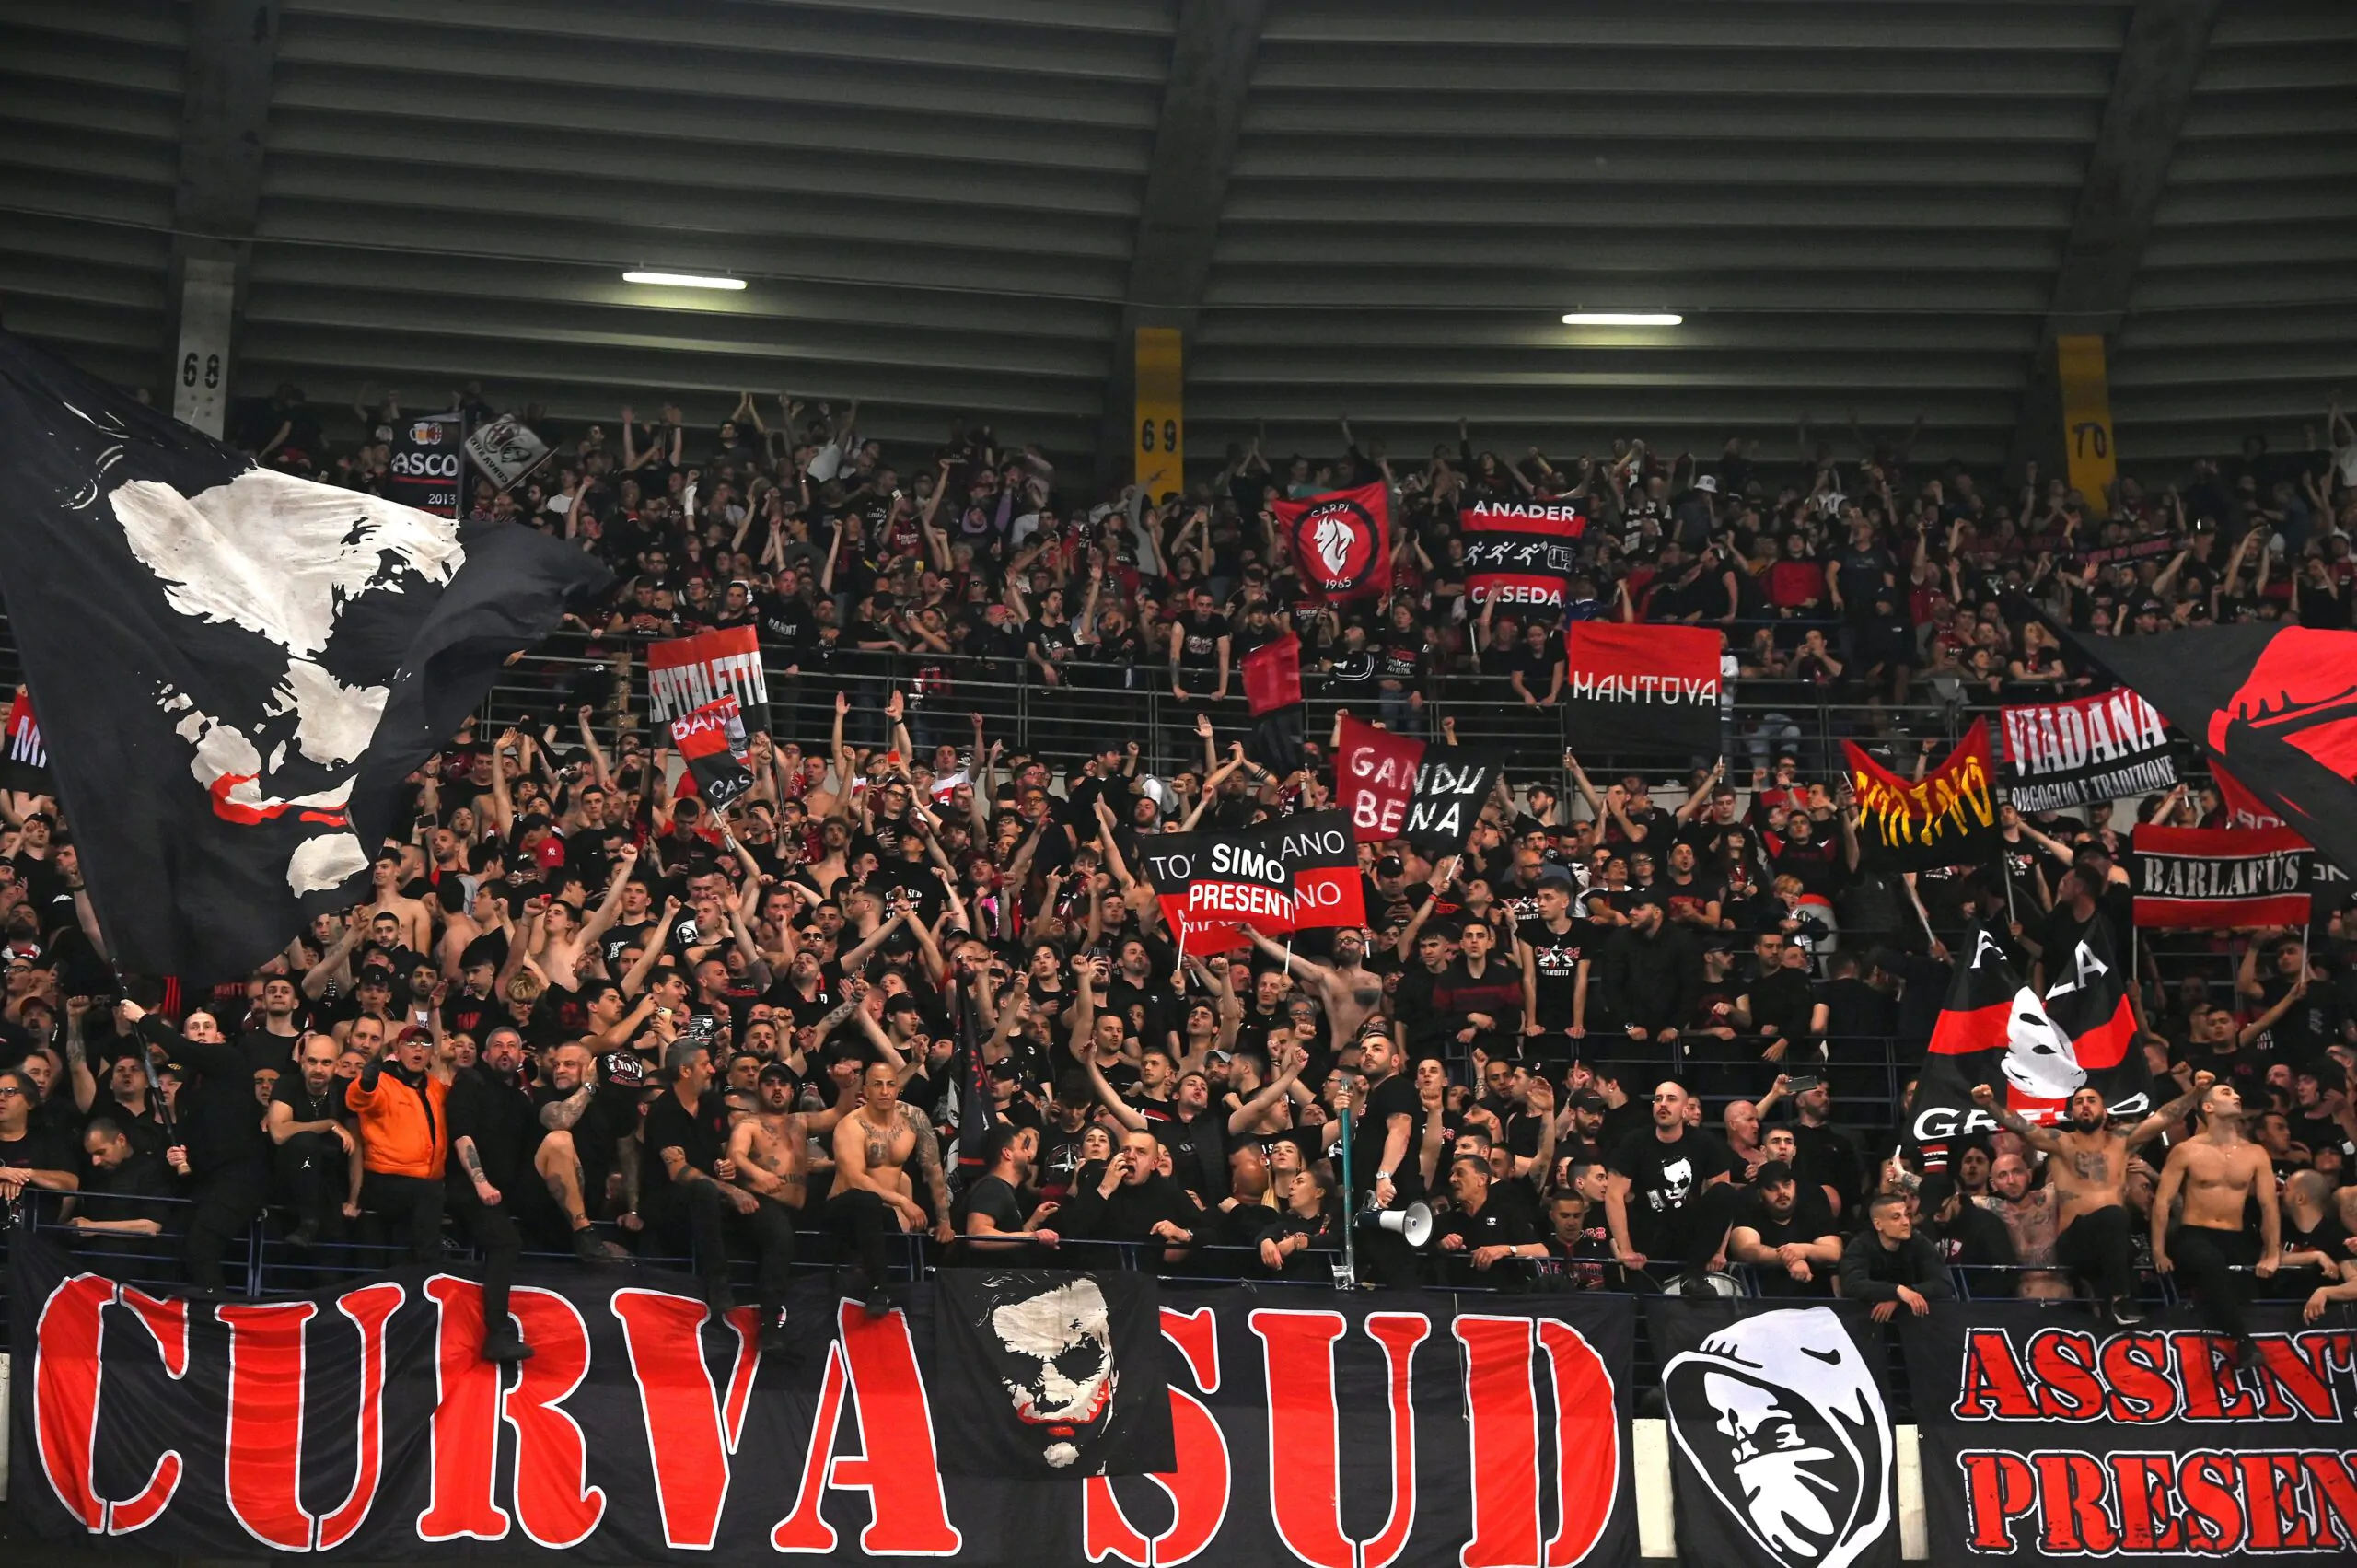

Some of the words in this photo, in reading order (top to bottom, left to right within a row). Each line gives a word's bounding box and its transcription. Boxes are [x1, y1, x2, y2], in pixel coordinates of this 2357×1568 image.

[183, 352, 220, 389] 68
[1141, 418, 1177, 453] 69
[428, 492, 457, 505] 2013
[1310, 503, 1350, 517] CARPI
[1325, 576, 1352, 589] 1965
[1573, 670, 1717, 707] MANTOVA
[2006, 690, 2168, 777] VIADANA
[1351, 747, 1487, 796] GANDU
[2012, 780, 2081, 812] ORGOGLIO
[2078, 779, 2090, 802] E
[2090, 755, 2177, 800] TRADIZIONE
[1353, 789, 1461, 838] BENA
[1210, 842, 1286, 884] SIMO
[2143, 850, 2301, 898] BARLAFÜS
[33, 1274, 962, 1557] CURVA
[1082, 1307, 1620, 1568] SUD
